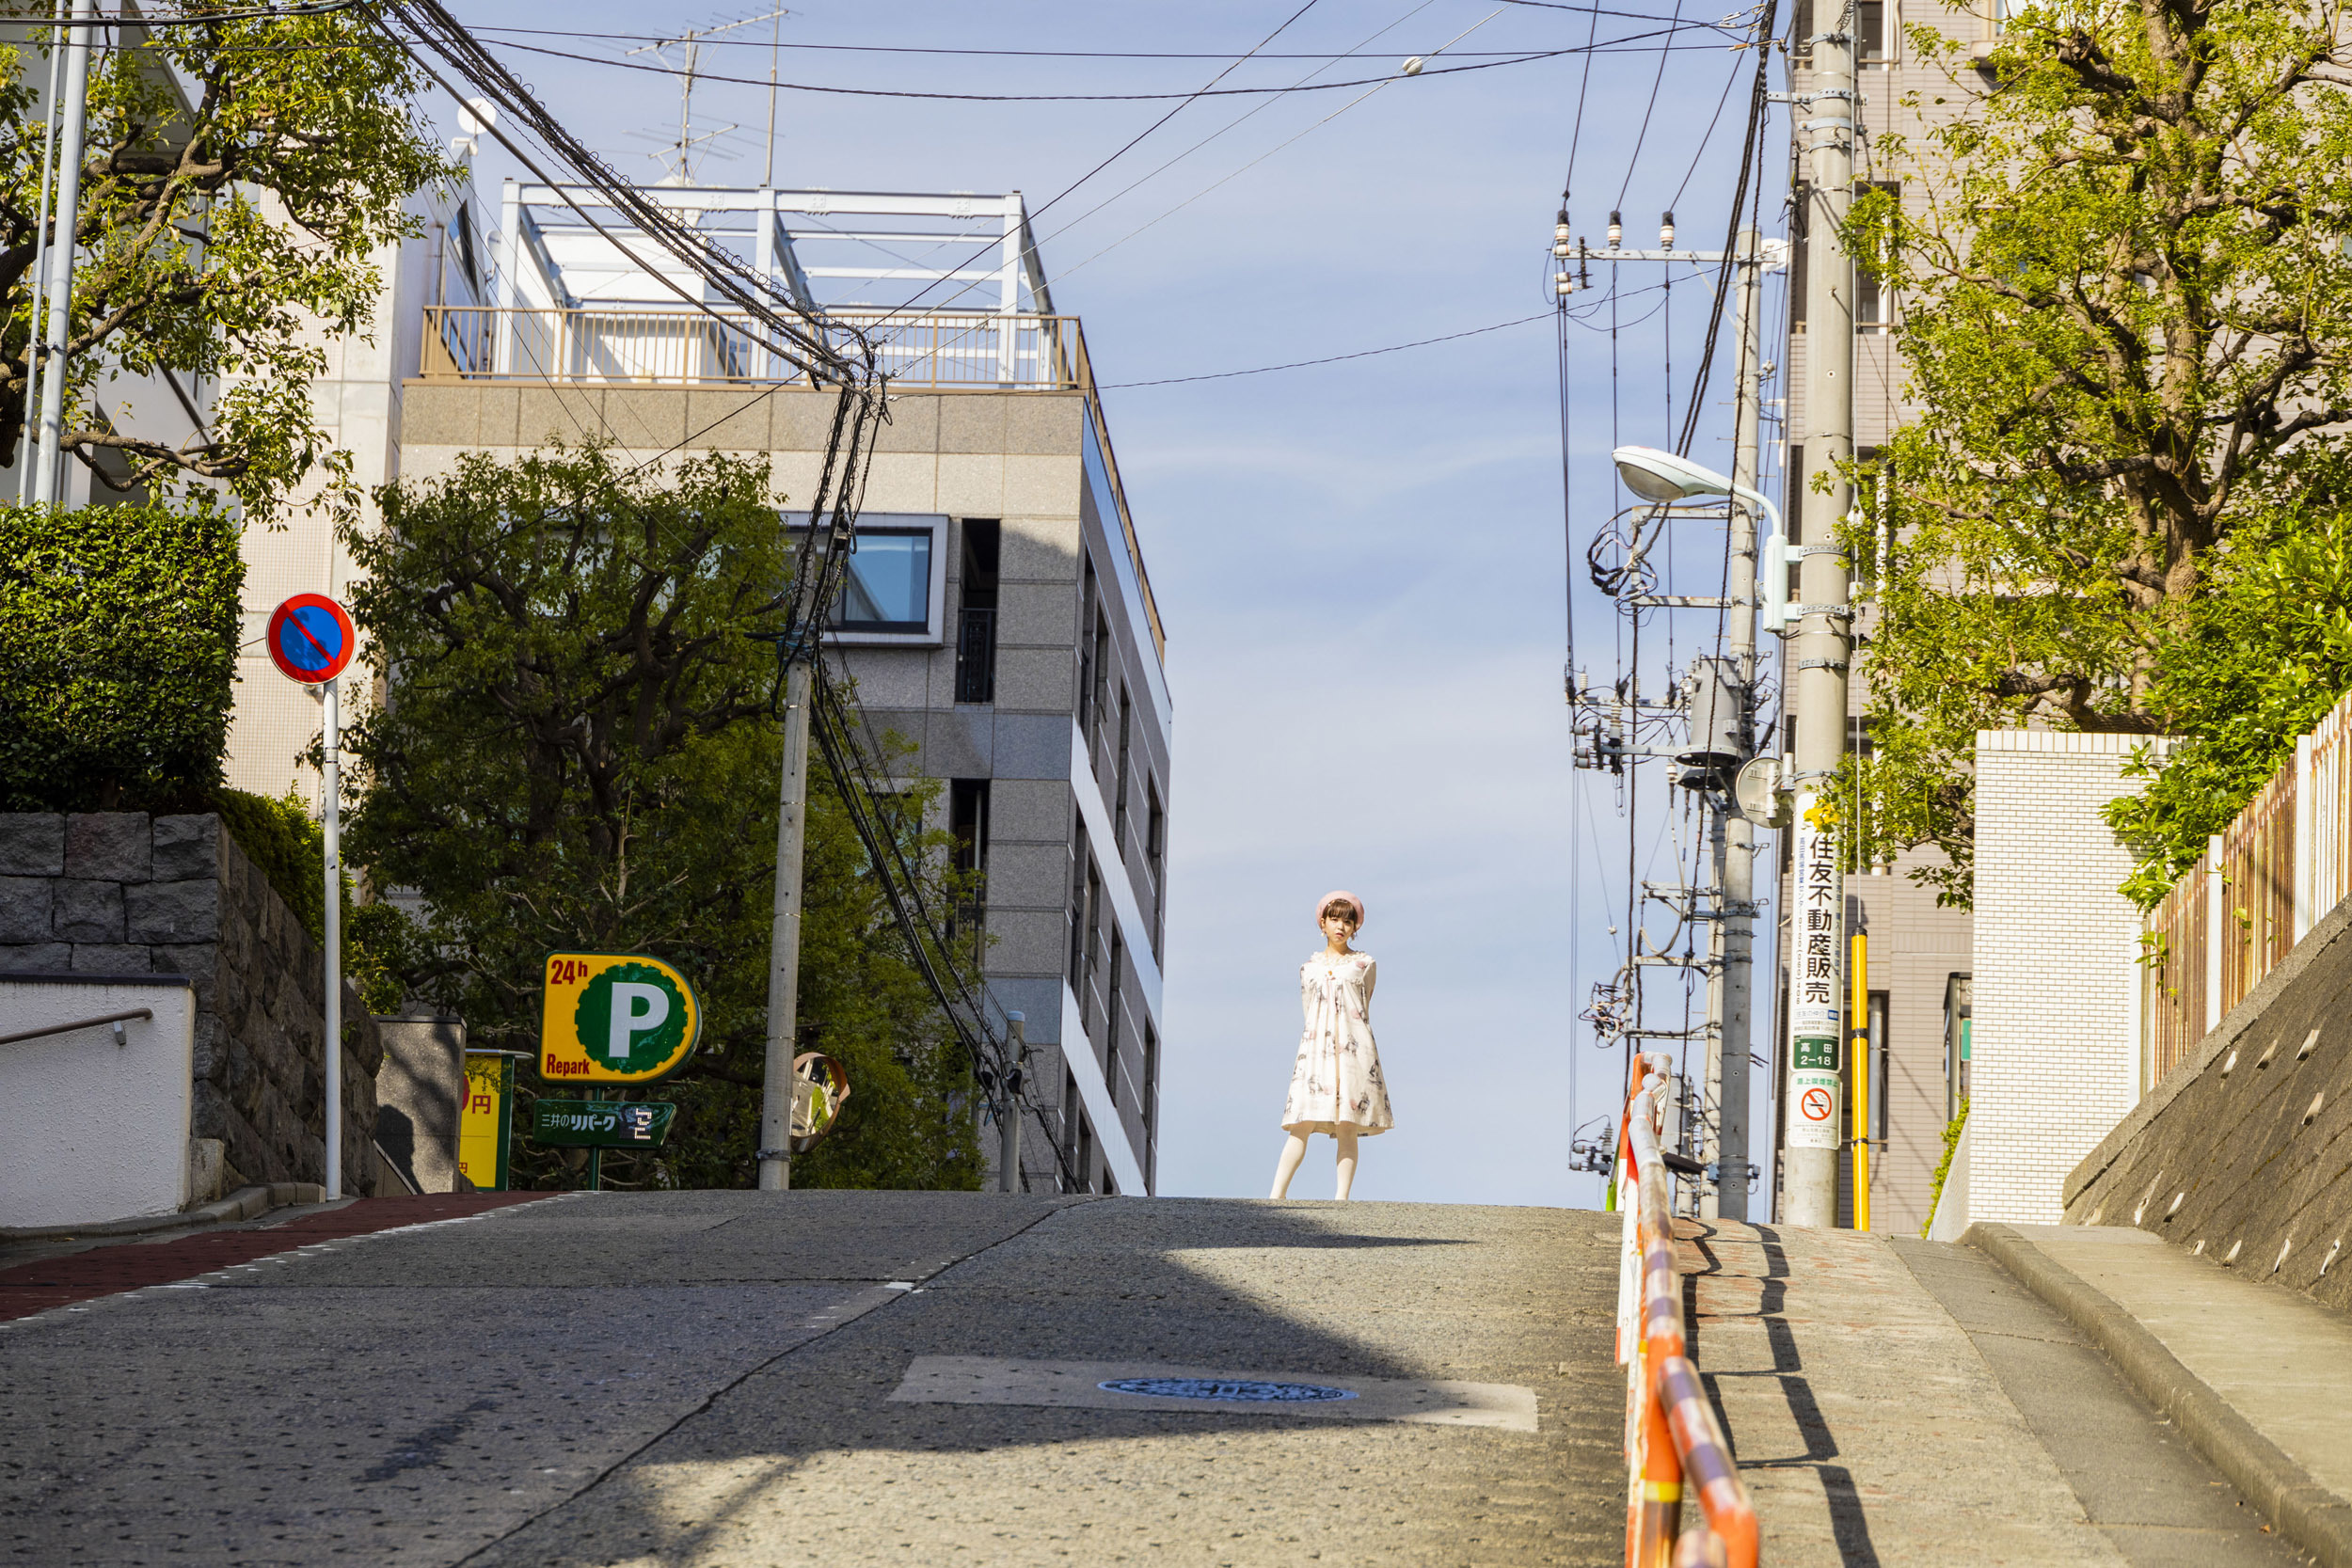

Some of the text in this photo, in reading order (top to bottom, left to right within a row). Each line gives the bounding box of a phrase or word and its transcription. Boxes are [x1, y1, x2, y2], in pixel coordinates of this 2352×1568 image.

[1804, 836, 1834, 1004] 住友不動産販売
[550, 959, 588, 985] 24h
[609, 981, 670, 1058] P
[546, 1053, 590, 1076] Repark
[1800, 1055, 1831, 1066] 2-18
[472, 1095, 491, 1115] 円
[541, 1114, 616, 1132] 三井のリパーク
